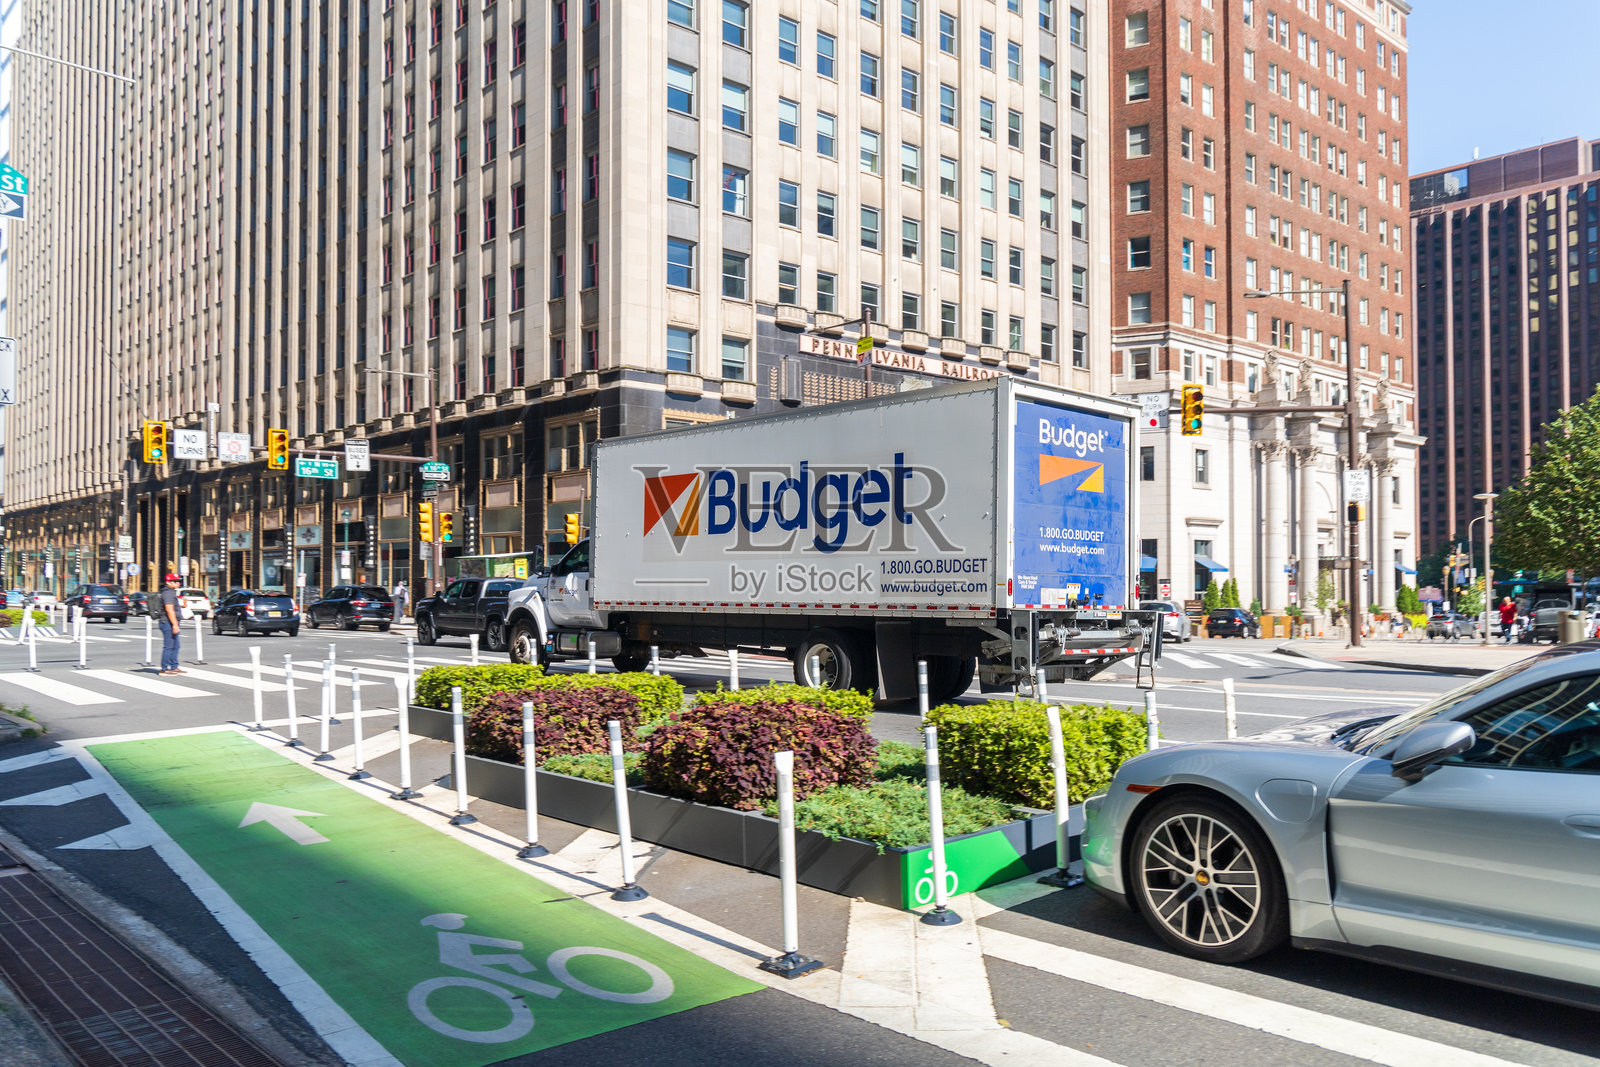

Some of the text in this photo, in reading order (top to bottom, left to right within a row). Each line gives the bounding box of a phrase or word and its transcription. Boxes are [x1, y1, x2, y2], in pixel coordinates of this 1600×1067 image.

[0, 174, 25, 193] St
[812, 338, 926, 372] PENNLVANIA
[183, 434, 197, 444] NO
[1039, 418, 1104, 457] Budget
[178, 446, 204, 456] TURNS
[323, 468, 334, 477] St
[708, 452, 913, 554] Budget
[1039, 527, 1104, 542] 1.800.GO.BUDGET
[1039, 543, 1105, 556] www.budget.com
[880, 559, 989, 575] 1.800.GO.BUDGET
[880, 580, 989, 597] www.budget.com
